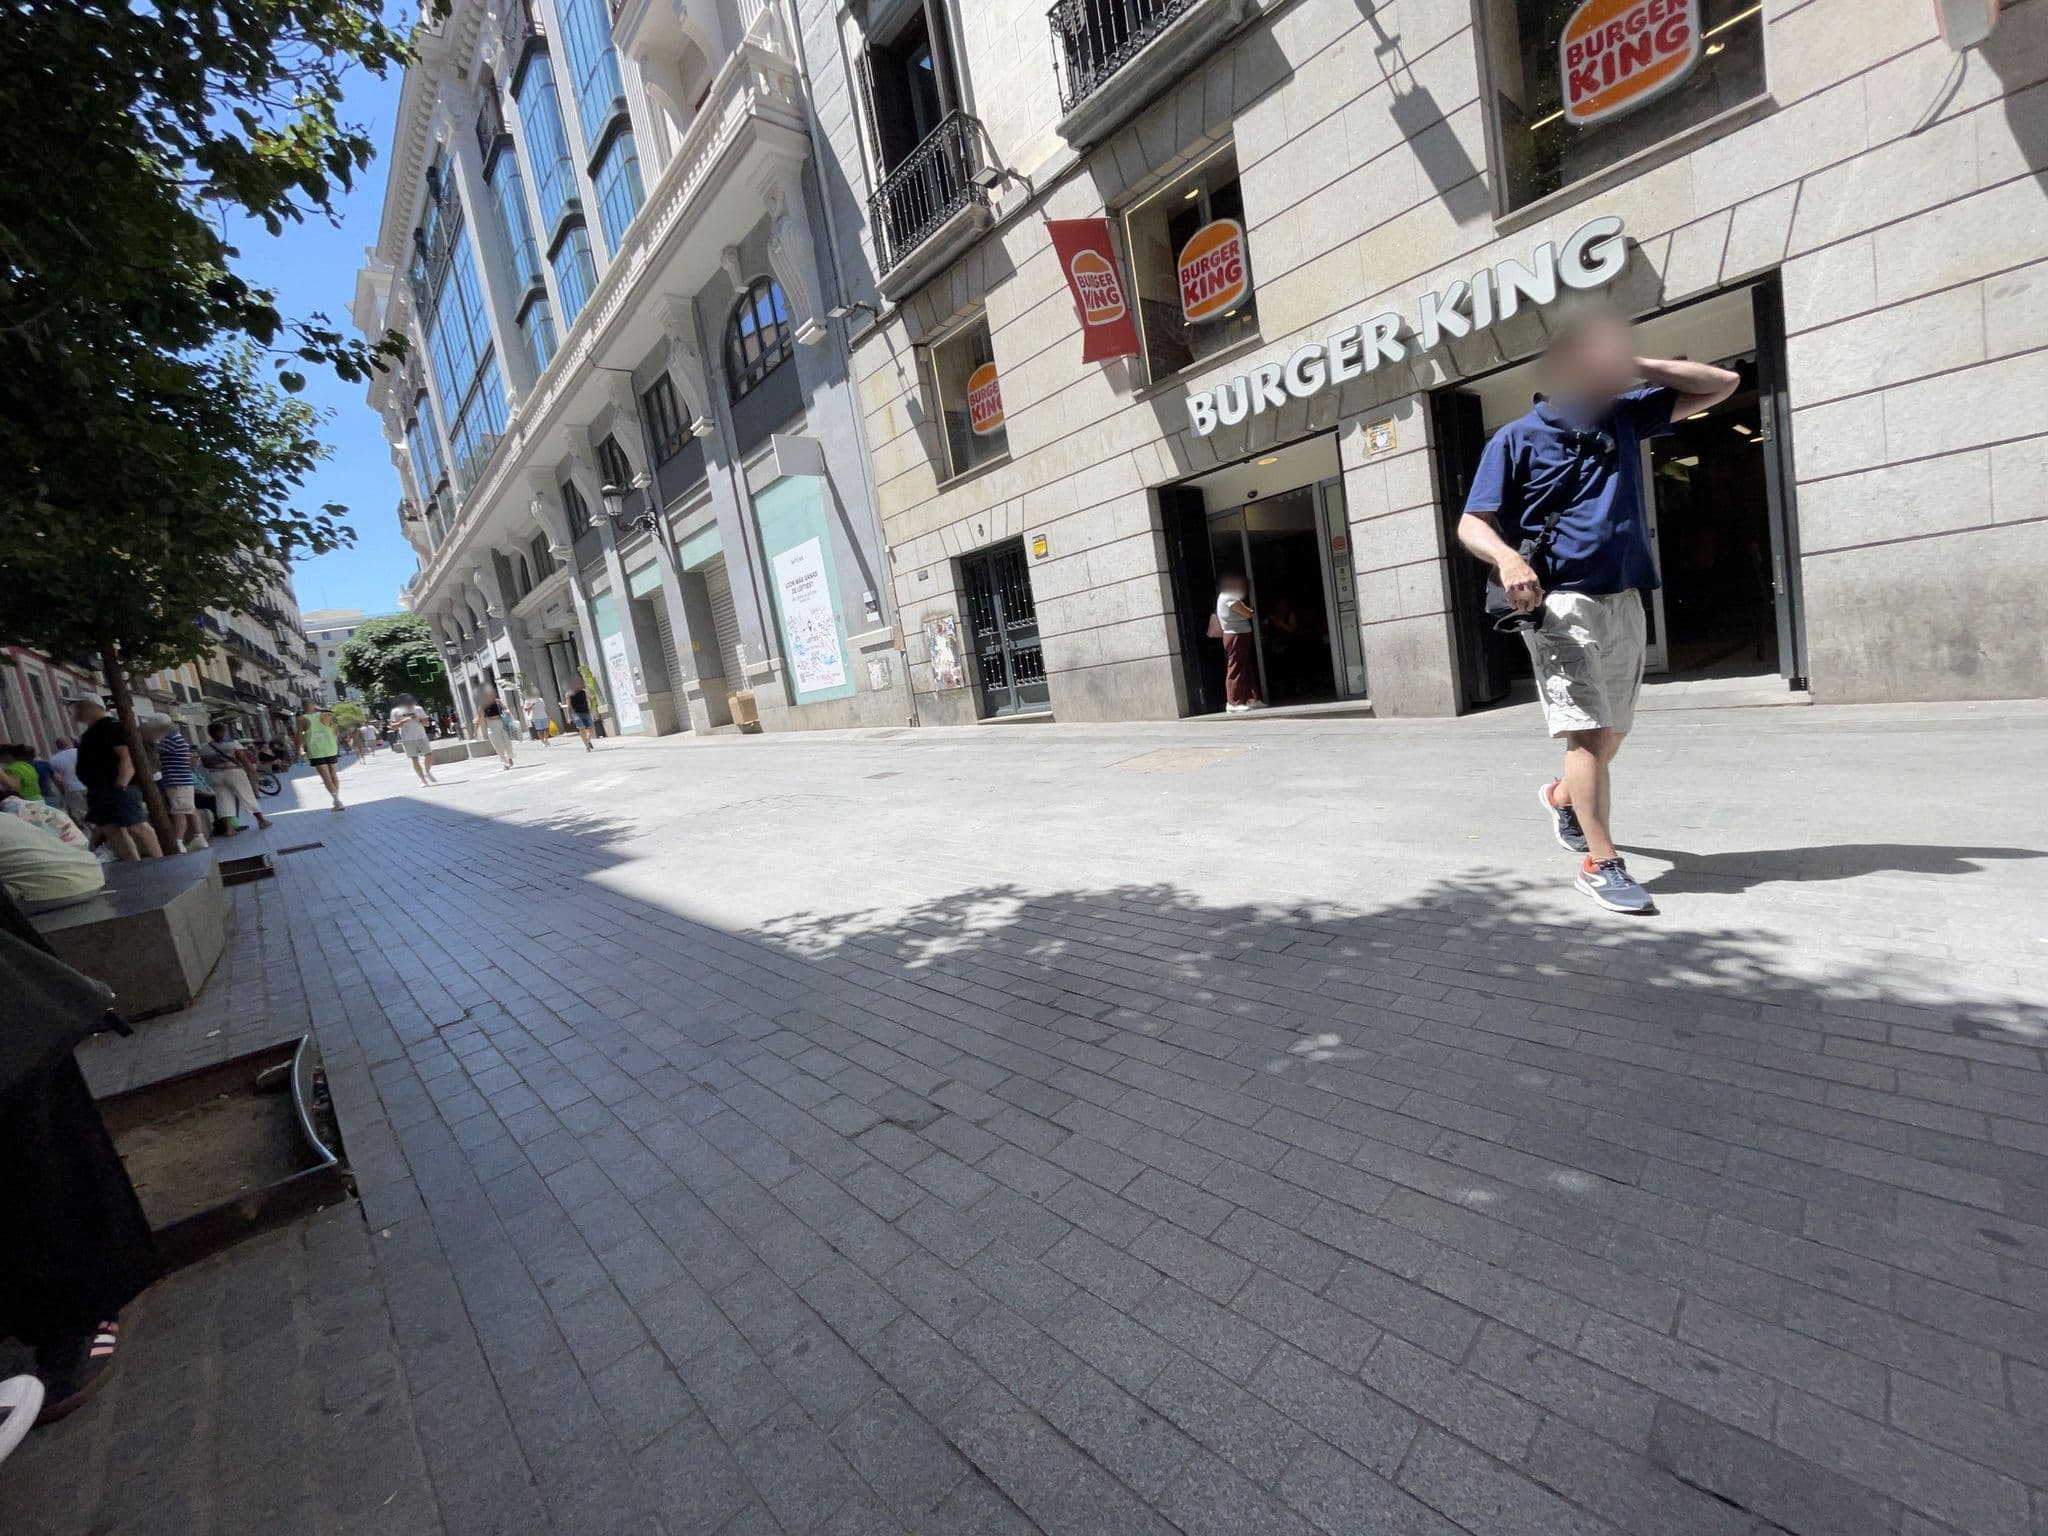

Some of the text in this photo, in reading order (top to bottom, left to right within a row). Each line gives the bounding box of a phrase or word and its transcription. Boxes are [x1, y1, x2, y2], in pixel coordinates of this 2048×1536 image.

[1568, 12, 1690, 103] KING
[1180, 239, 1241, 284] BURGER
[1183, 257, 1243, 308] KING
[1185, 214, 1629, 438] BURGER KING
[969, 381, 1000, 407] BURGE
